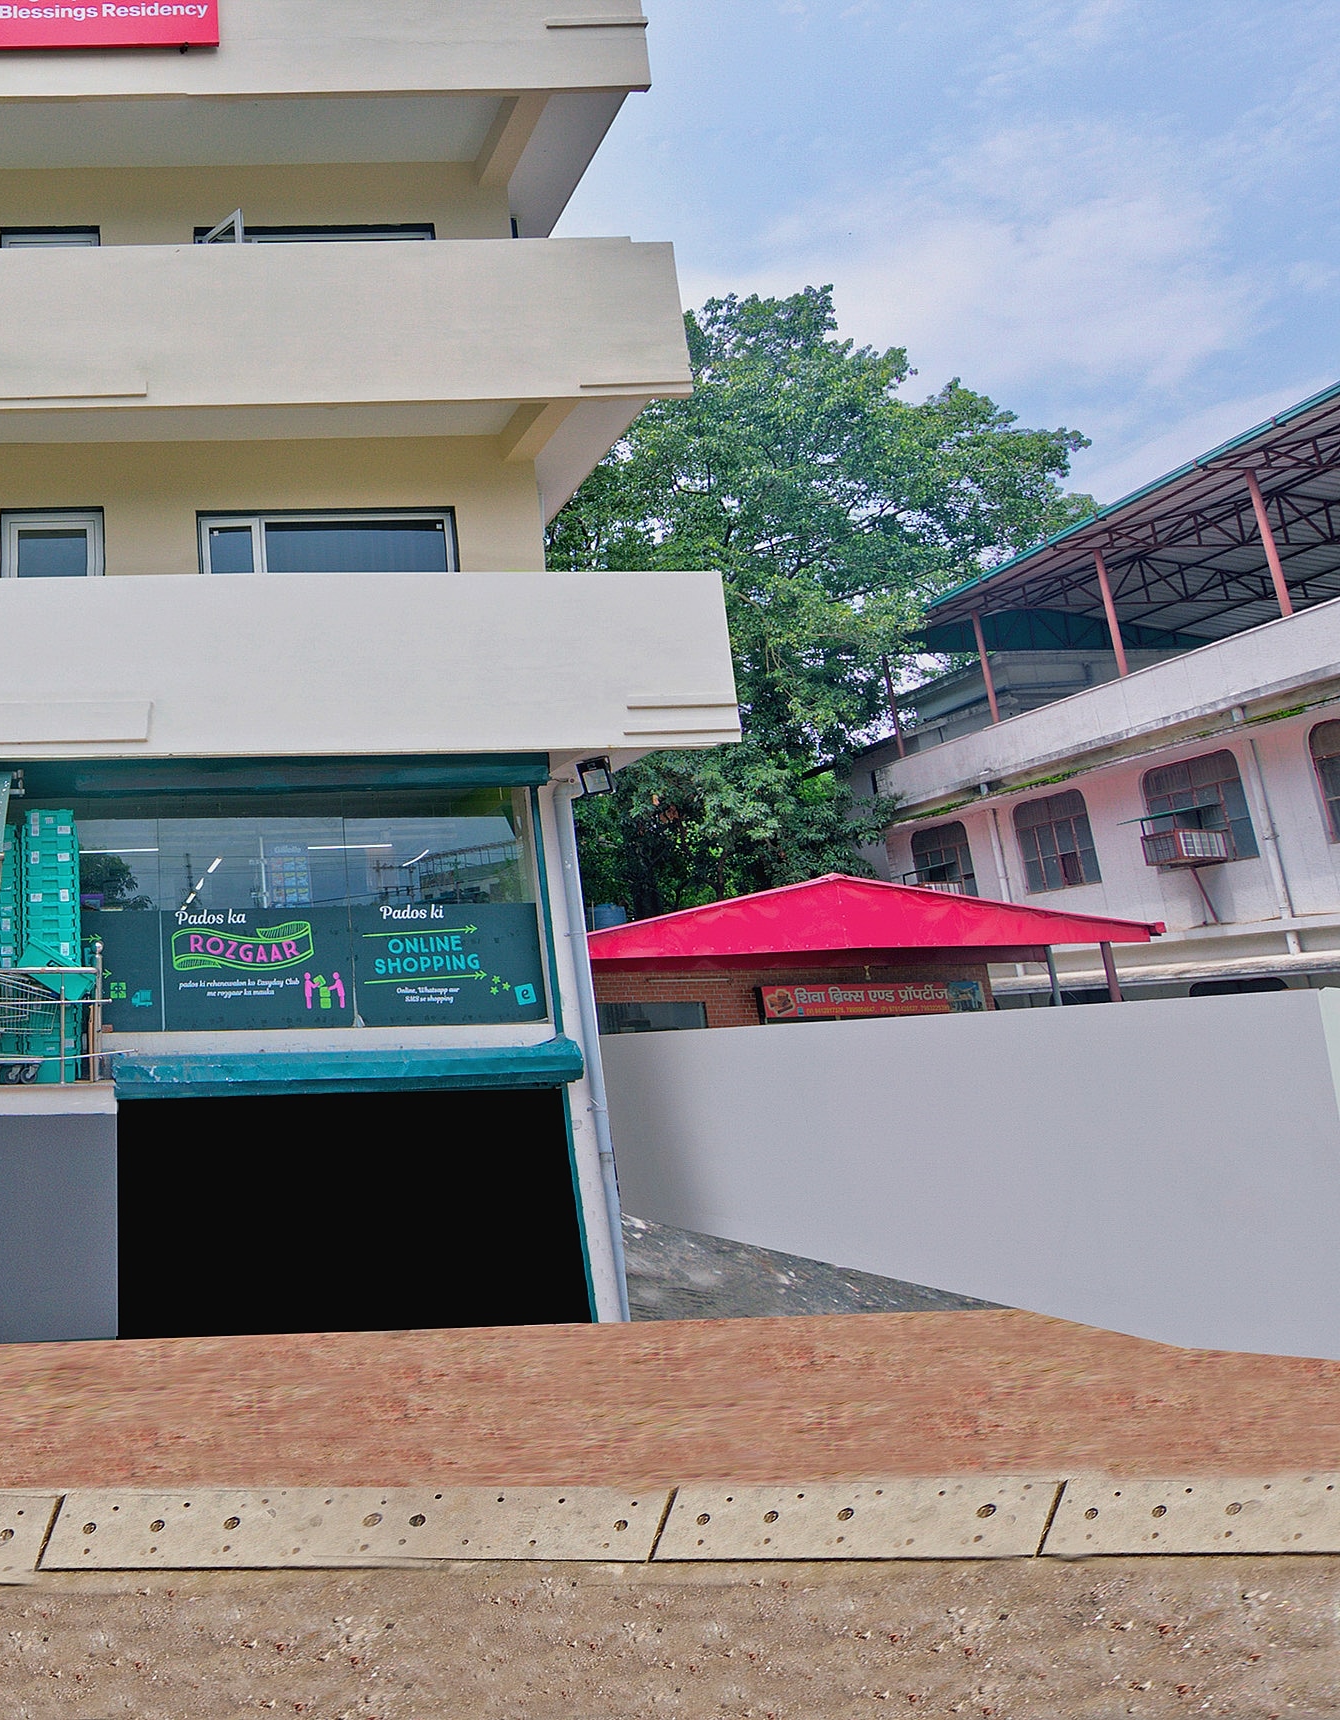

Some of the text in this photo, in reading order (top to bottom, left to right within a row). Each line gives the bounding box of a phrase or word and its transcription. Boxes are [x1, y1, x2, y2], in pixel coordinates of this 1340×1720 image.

[101, 2, 209, 19] Residency
[175, 908, 247, 926] Pados ka
[380, 903, 445, 920] Pados ki
[189, 934, 300, 963] ROZGAAR
[387, 935, 463, 955] ONLINE
[374, 953, 481, 975] SHOPPING
[794, 987, 826, 1004] शिवा
[828, 986, 865, 1005] ब्रिक्स
[867, 988, 895, 1003] एण्ड
